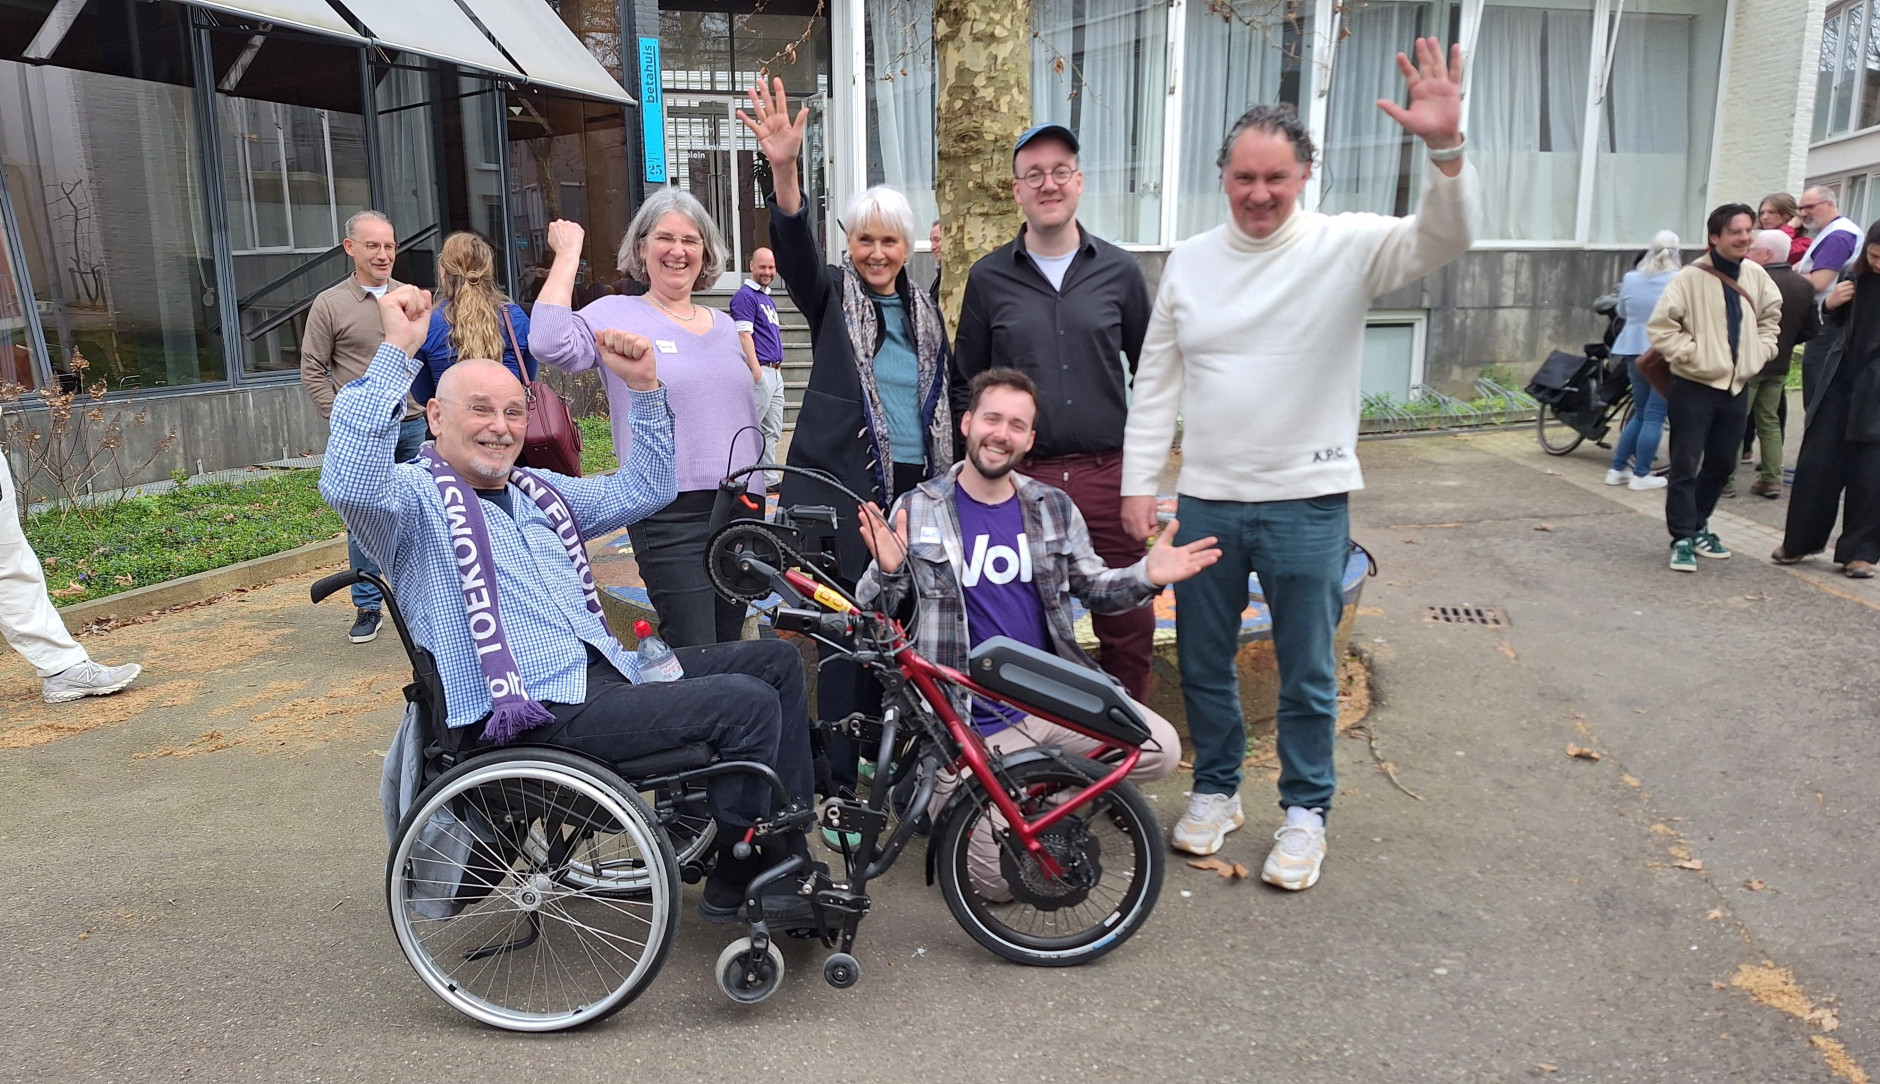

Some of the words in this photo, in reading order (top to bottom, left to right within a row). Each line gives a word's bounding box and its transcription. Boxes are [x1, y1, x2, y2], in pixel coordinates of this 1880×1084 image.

[643, 45, 655, 103] betahuis
[648, 165, 662, 175] 25
[486, 671, 520, 698] olt
